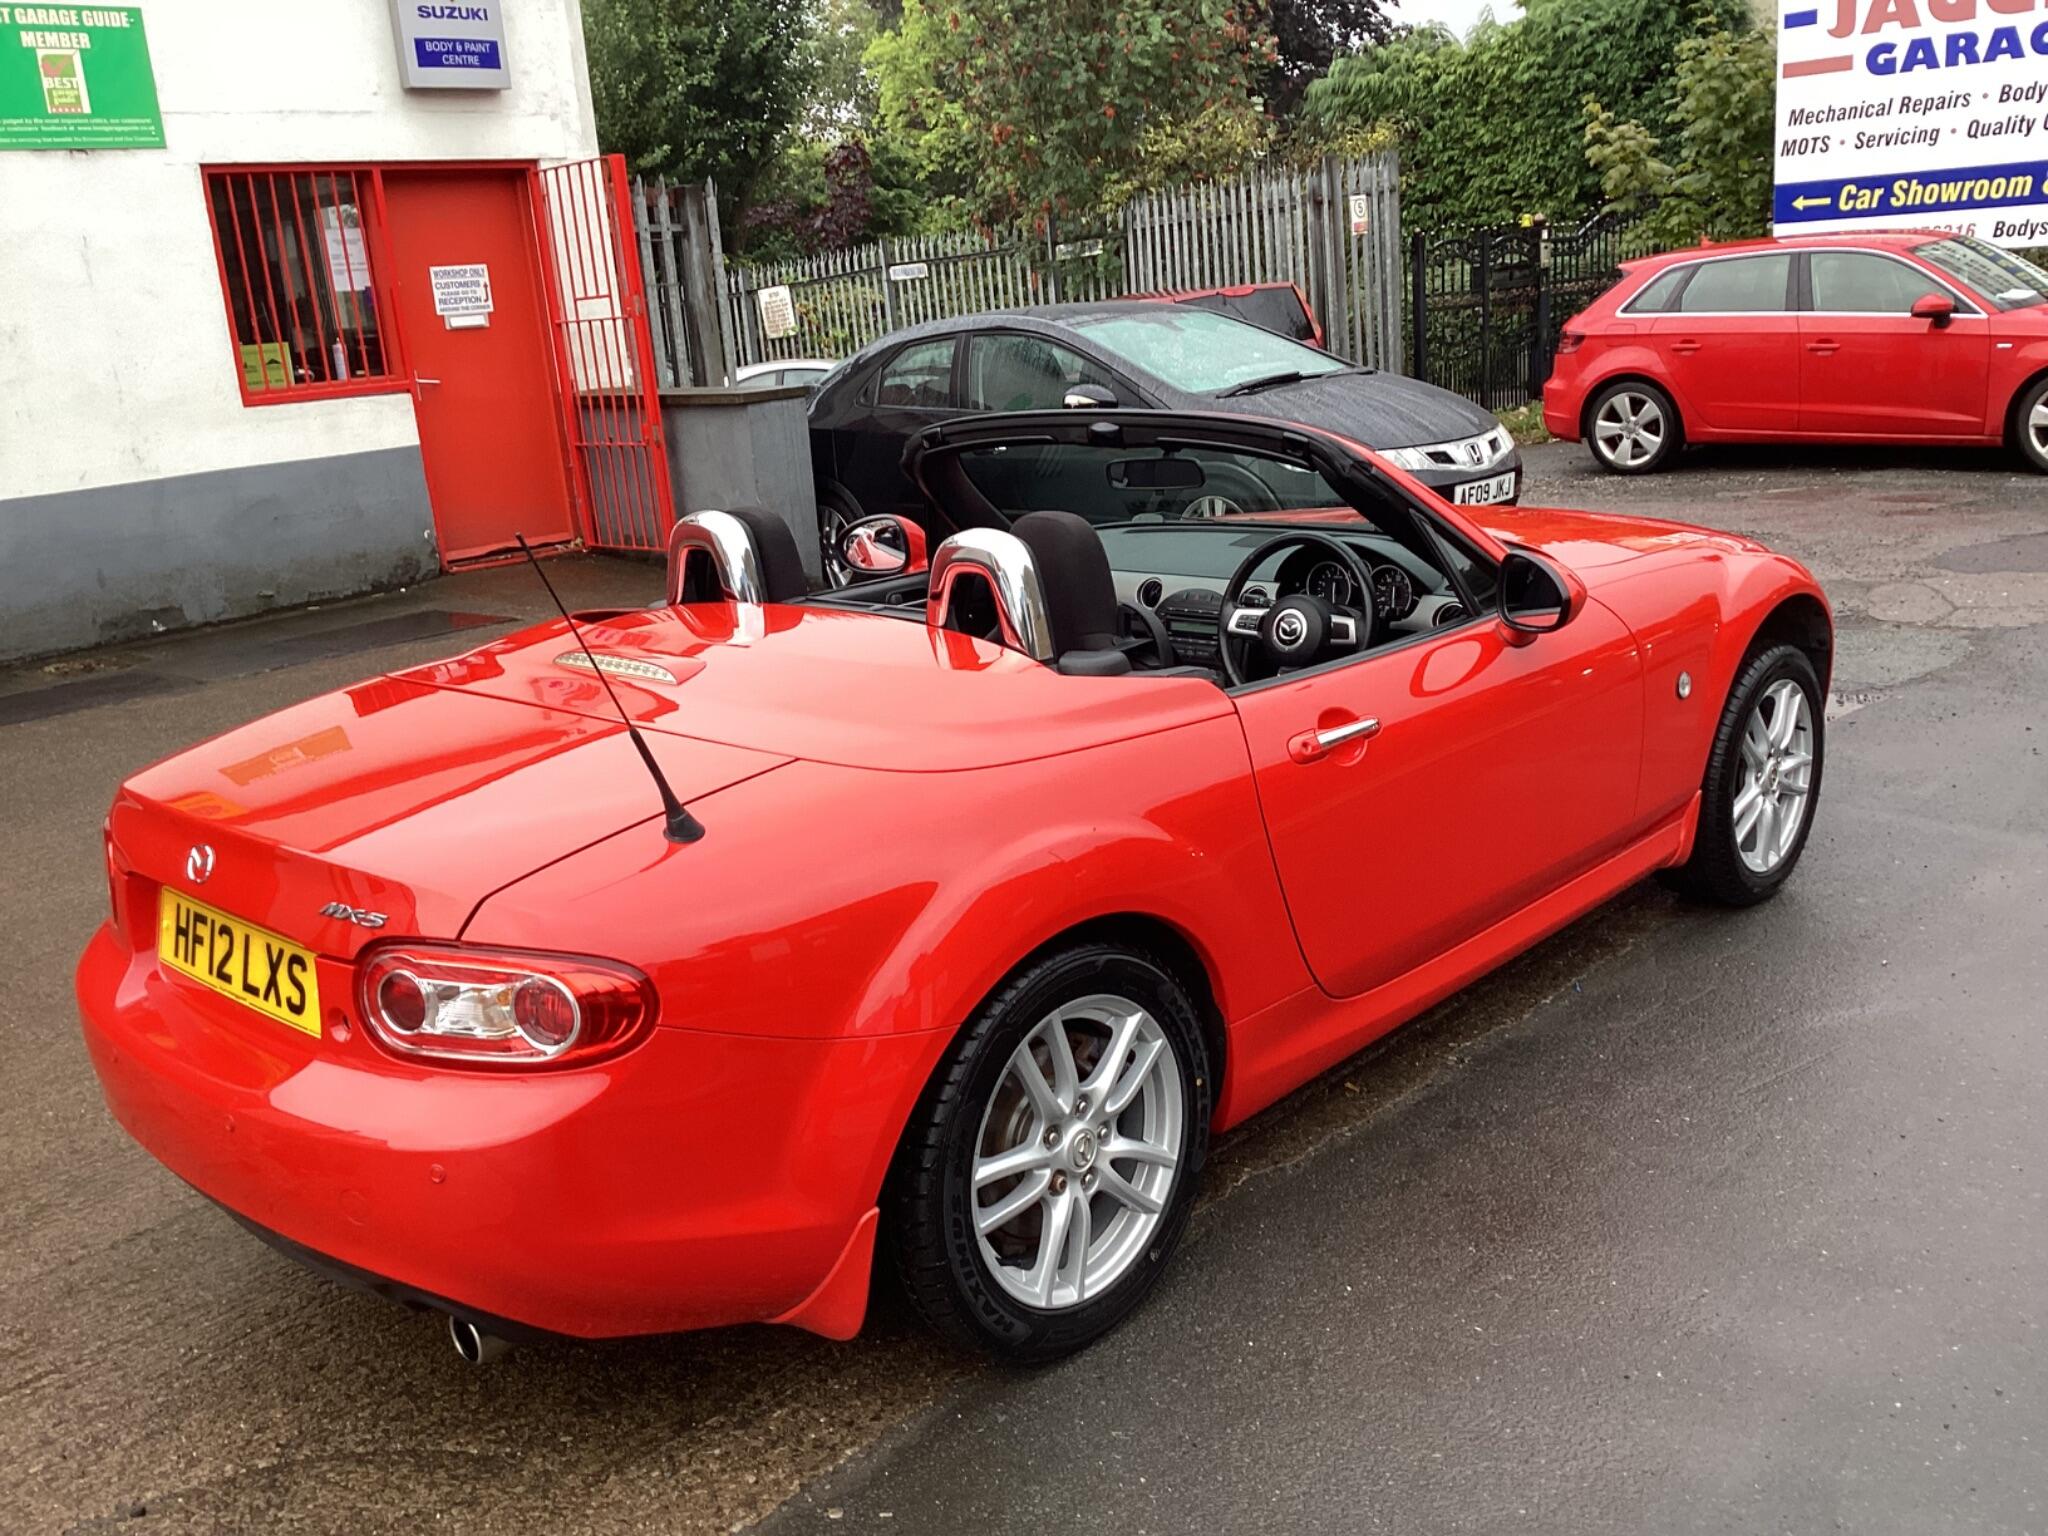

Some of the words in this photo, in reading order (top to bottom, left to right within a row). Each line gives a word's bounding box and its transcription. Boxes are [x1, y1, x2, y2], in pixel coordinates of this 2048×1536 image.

[14, 7, 80, 26] GARAGE
[82, 10, 131, 28] GUIDE
[417, 5, 488, 21] SUZUKI
[19, 31, 91, 49] MEMBER
[424, 41, 454, 52] BODY
[456, 42, 463, 52] &
[464, 42, 491, 52] PAINT
[442, 54, 480, 65] CENTRE
[45, 77, 79, 89] BEST
[1788, 98, 1894, 127] Mechanical
[1899, 90, 1971, 116] Repairs
[1780, 135, 1831, 157] MOTS
[1854, 127, 1941, 150] Servicing
[1967, 114, 2036, 139] Quality
[1838, 184, 1885, 212] Car
[1890, 174, 2033, 208] Showroom
[435, 280, 481, 290] CUSTOMERS
[438, 296, 482, 306] RECEPTION
[1461, 483, 1491, 505] AF09
[1492, 476, 1512, 500] JKJ
[174, 903, 234, 985] HF12
[242, 933, 308, 1016] LXS
